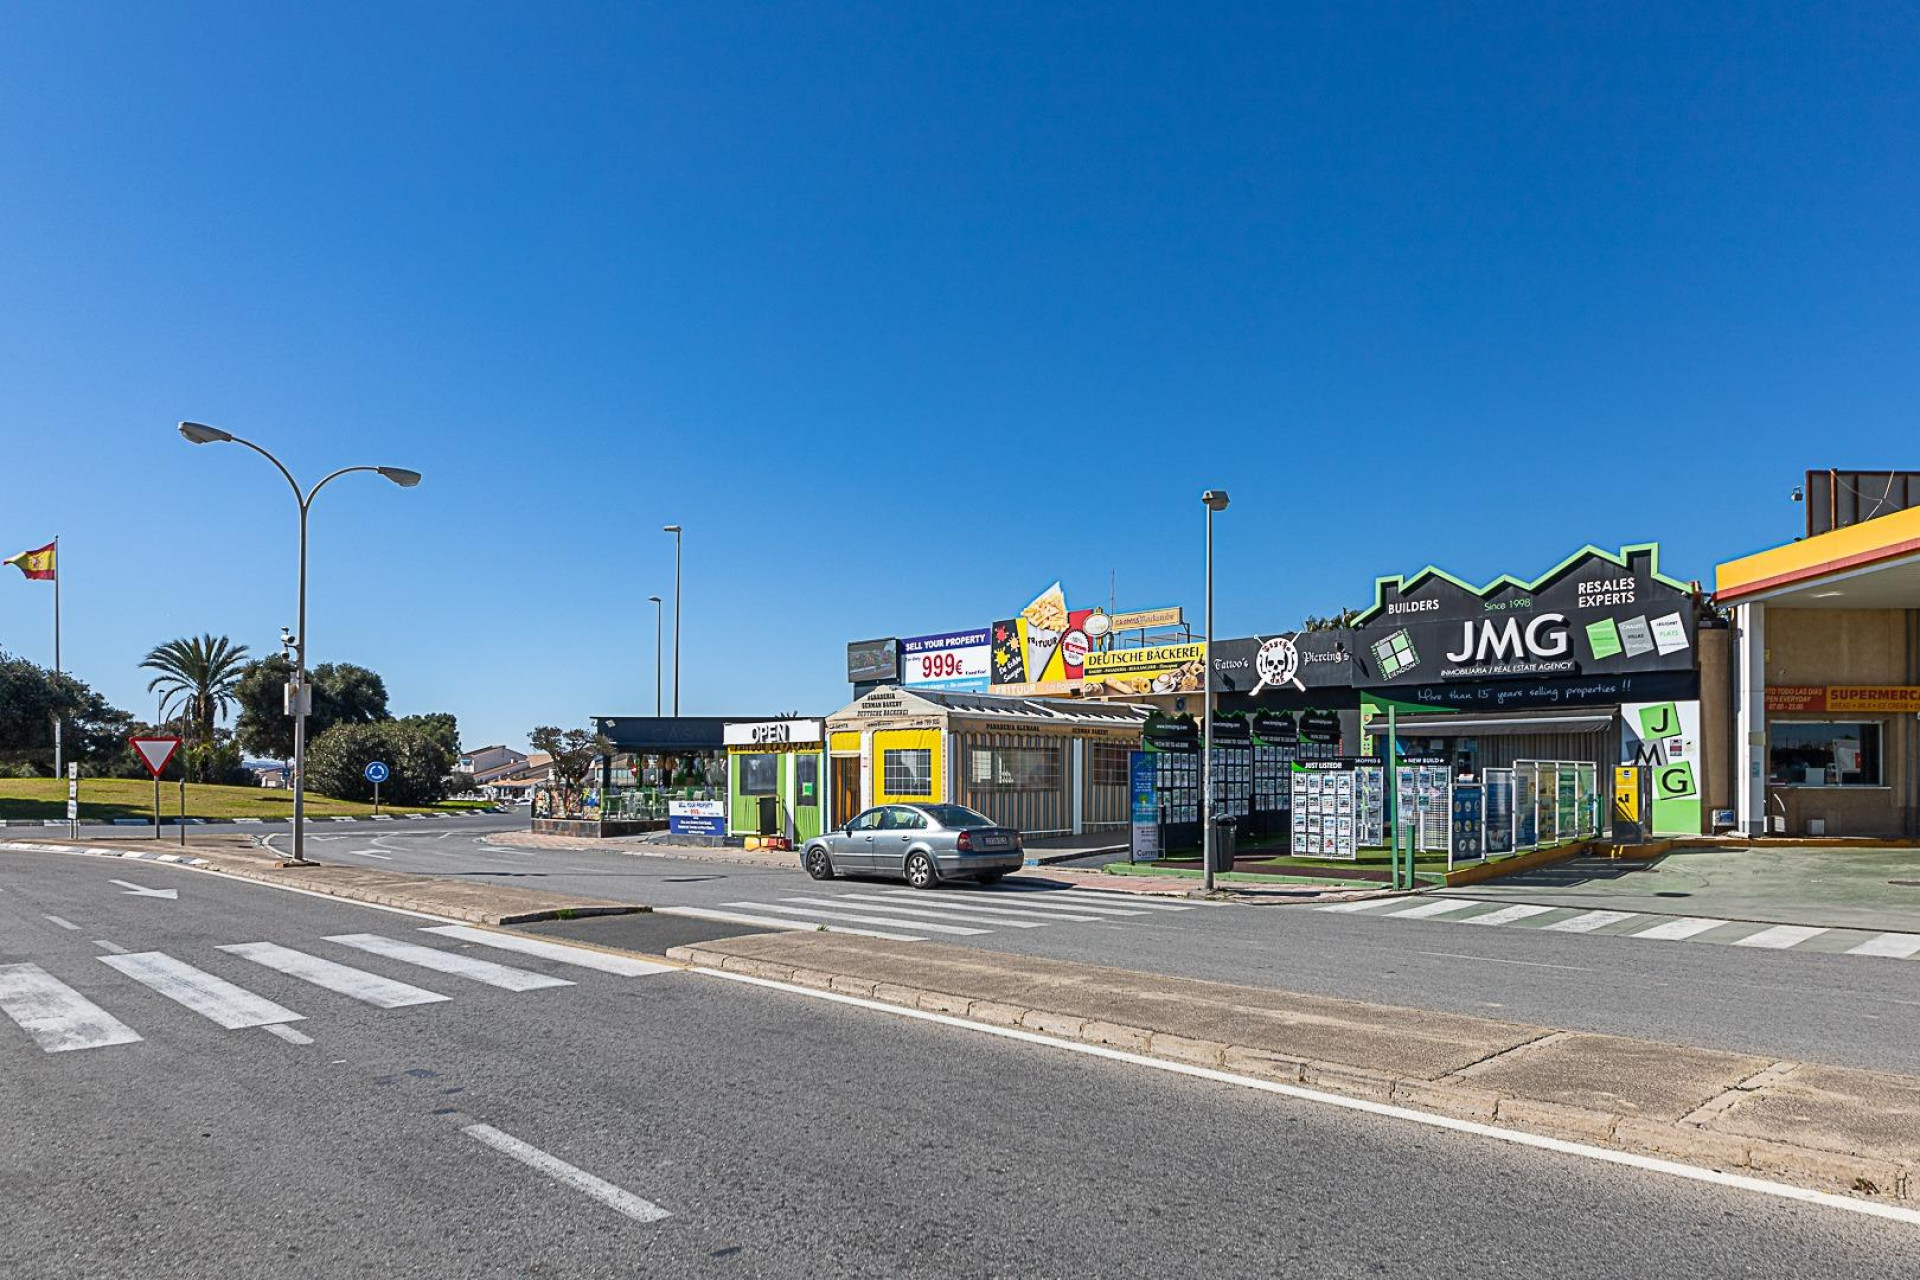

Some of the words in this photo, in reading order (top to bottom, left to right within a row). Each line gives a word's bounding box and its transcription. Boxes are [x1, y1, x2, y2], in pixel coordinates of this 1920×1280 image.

[1578, 577, 1635, 594] RESALES
[1388, 599, 1440, 614] BUILDERS
[1484, 602, 1506, 611] Since
[1509, 599, 1531, 608] 1998
[1578, 591, 1635, 608] EXPERTS
[905, 642, 922, 652] SELL
[924, 639, 944, 649] YOUR
[945, 634, 985, 647] PROPERTY
[1027, 636, 1058, 648] FRITUUR
[1446, 613, 1567, 662] JMG
[922, 653, 963, 678] 999€
[1088, 651, 1145, 666] DEUTSCHE
[1146, 646, 1199, 661] BÄCKEREI
[1494, 665, 1512, 673] REAL
[1512, 664, 1537, 672] ESTATE
[1538, 662, 1572, 671] AGENCY
[1417, 688, 1442, 701] More
[1450, 690, 1472, 700] than
[1497, 689, 1523, 704] years
[1530, 686, 1558, 700] selling
[1566, 684, 1616, 699] properties
[1622, 679, 1631, 692] !!
[1651, 708, 1668, 733] J
[752, 724, 787, 743] OPEN
[1634, 743, 1662, 766] M
[1661, 768, 1688, 793] G
